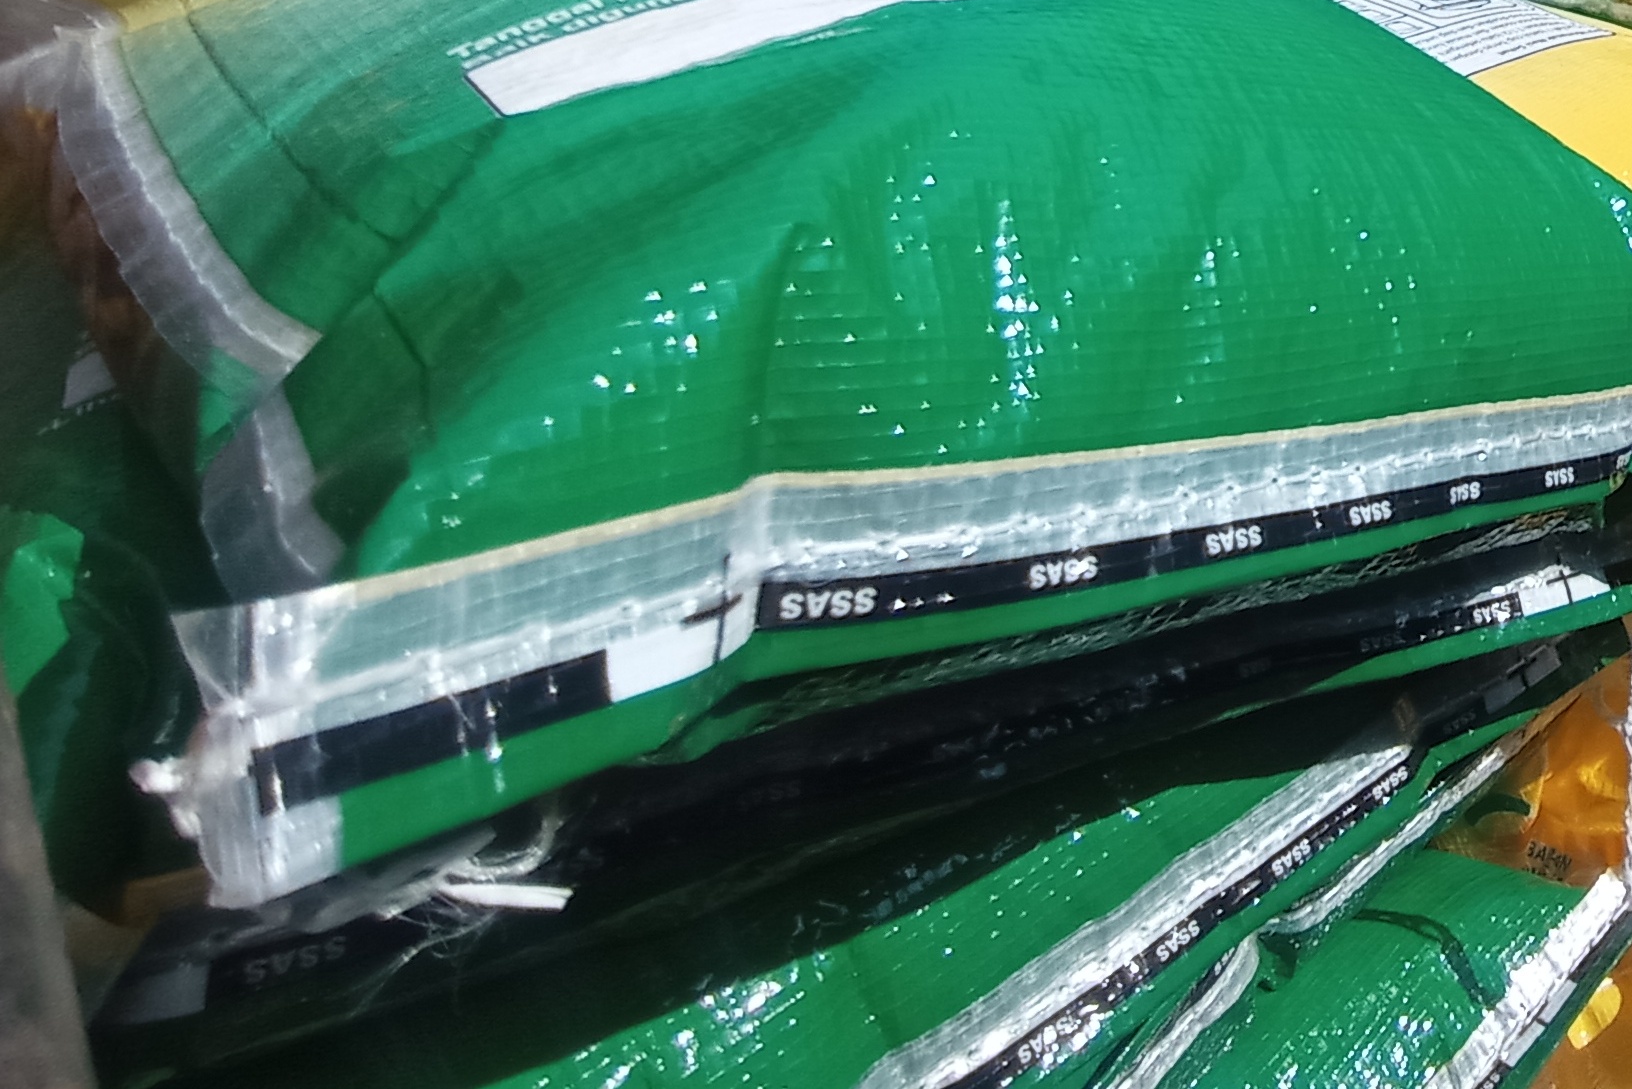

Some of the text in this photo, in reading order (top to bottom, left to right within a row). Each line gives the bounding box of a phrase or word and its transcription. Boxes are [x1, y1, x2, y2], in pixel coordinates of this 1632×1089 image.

[1347, 499, 1394, 528] SSAS
[1203, 524, 1264, 557] SSAS
[1027, 553, 1100, 591] SSAS
[779, 585, 879, 622] SSAS
[242, 934, 348, 984] SSAS
